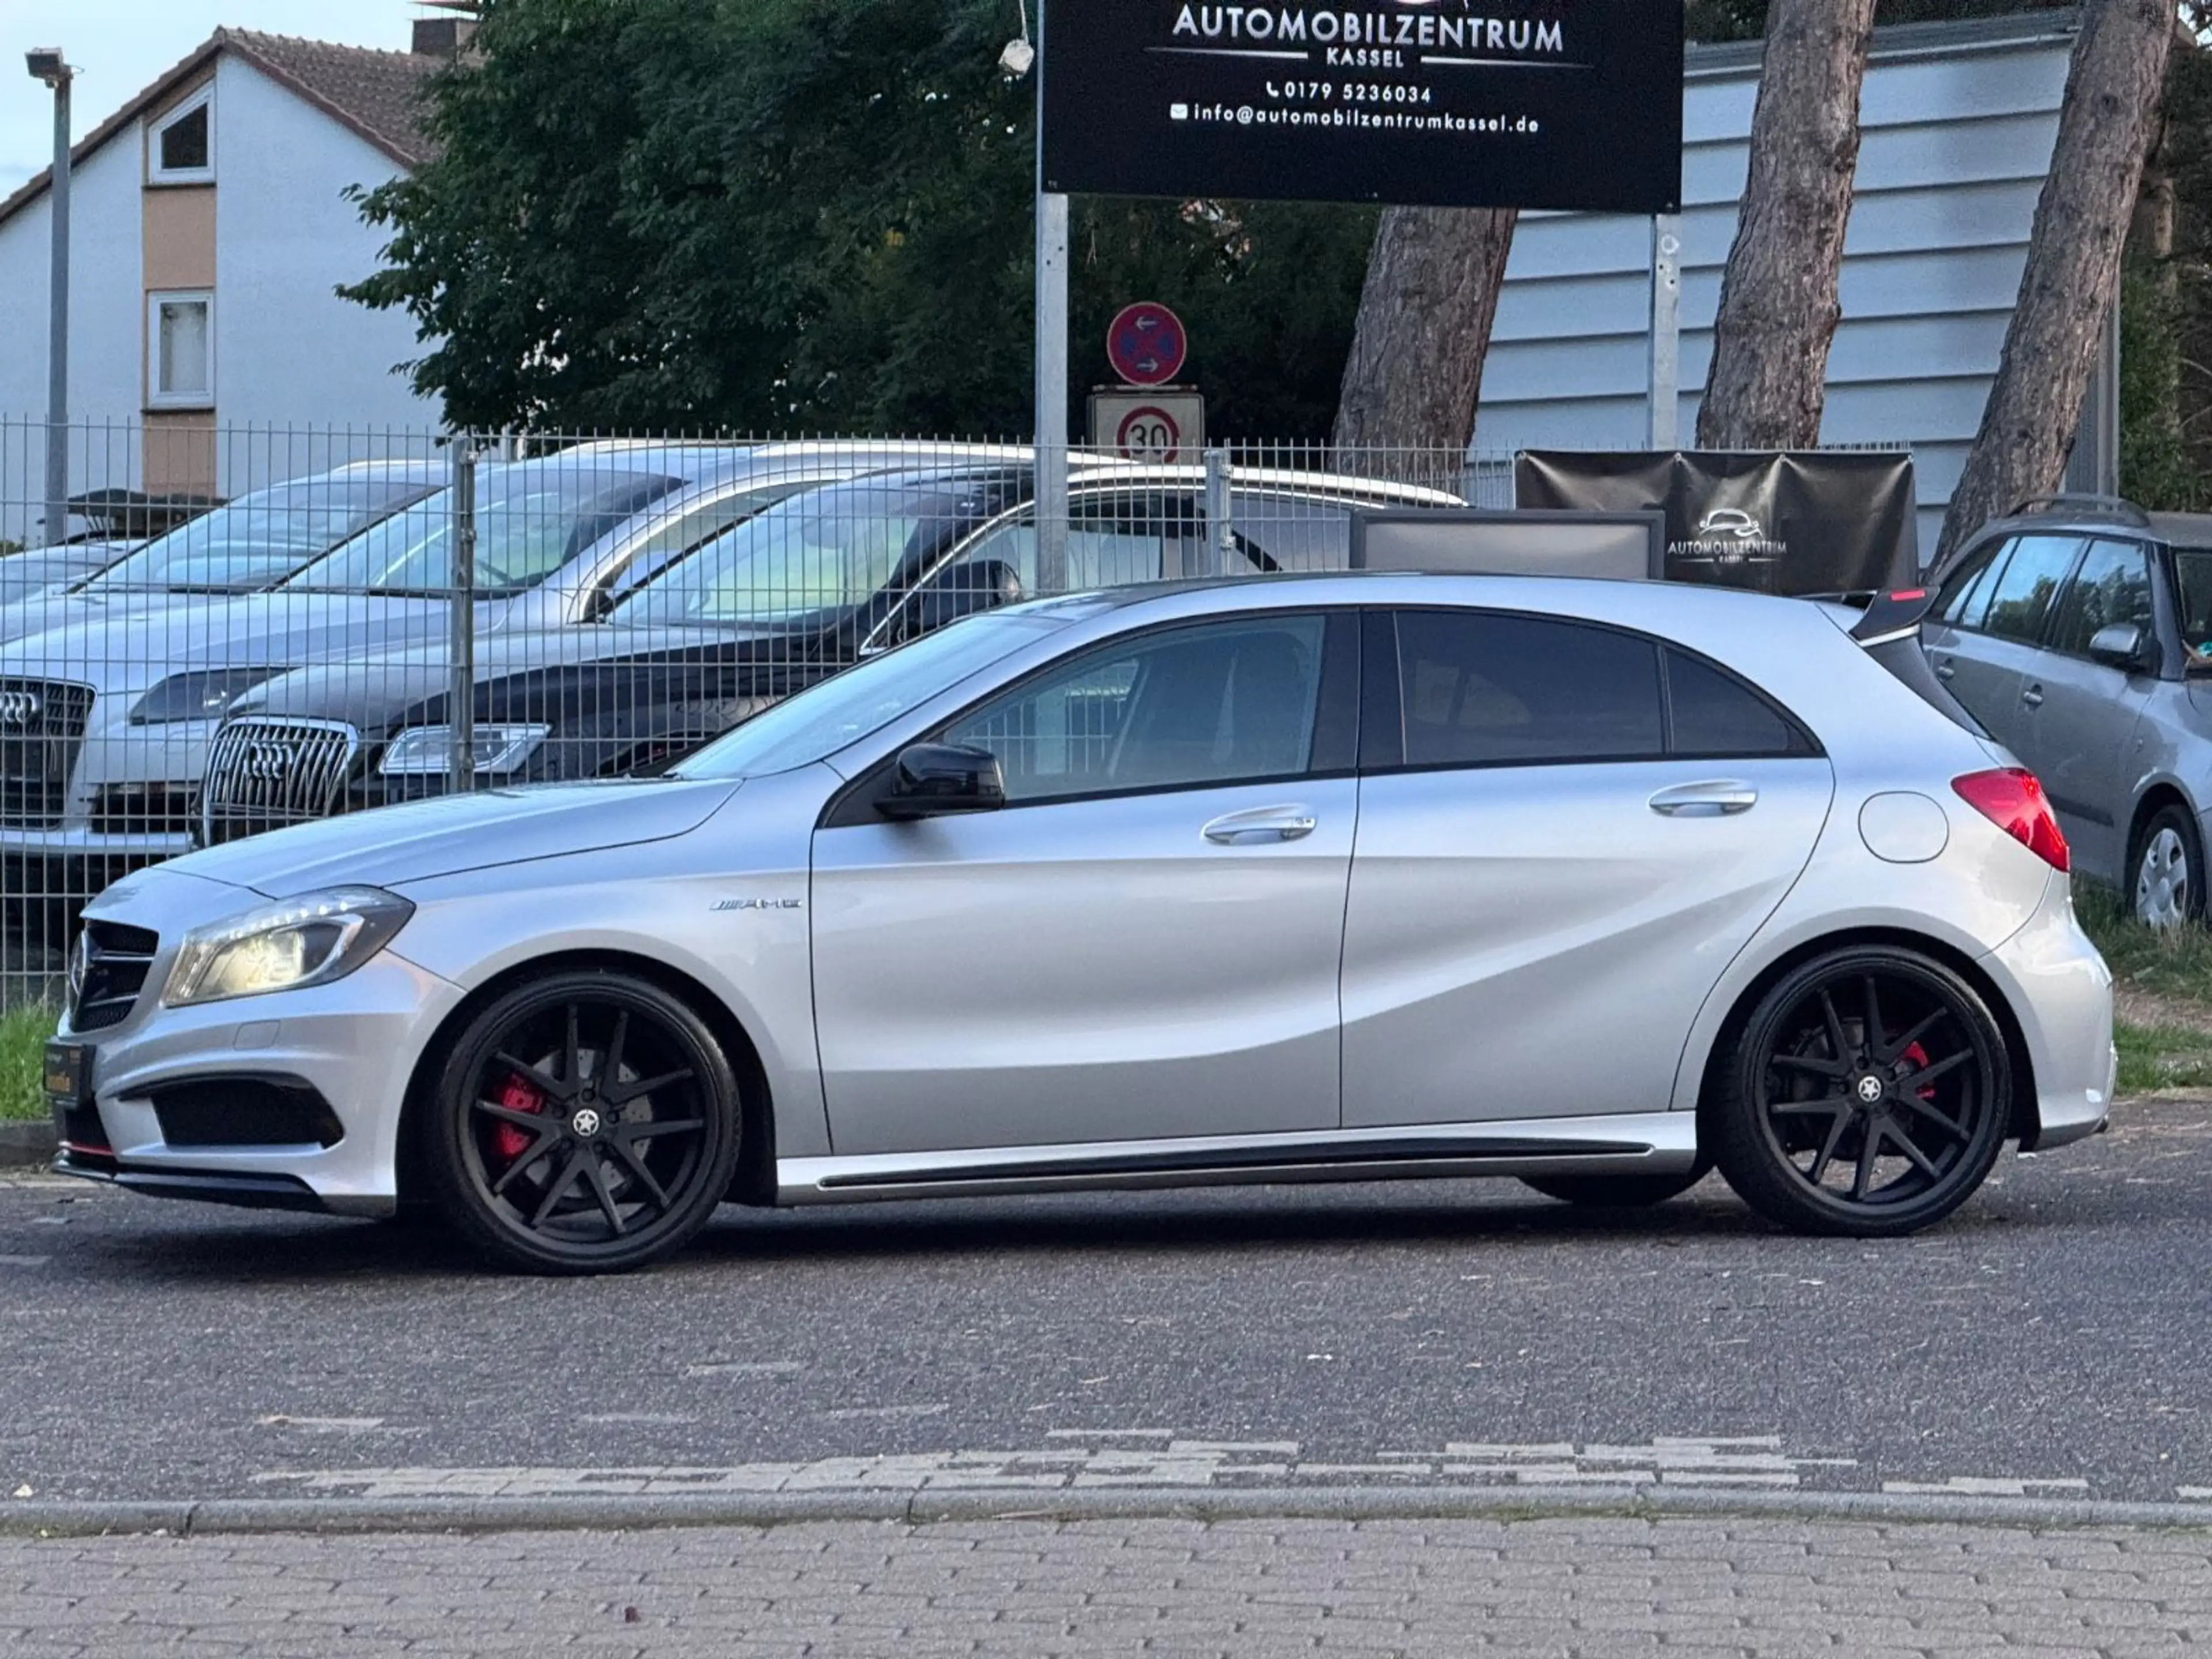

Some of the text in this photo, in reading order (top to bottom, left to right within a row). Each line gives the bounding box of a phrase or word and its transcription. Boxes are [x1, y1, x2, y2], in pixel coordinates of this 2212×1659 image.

[1172, 3, 1563, 52] AUTOMOBILZENTRUM
[1327, 46, 1404, 68] KASSEL
[1285, 81, 1431, 103] 0179 5236034
[1194, 103, 1539, 132] info@automobilzentrumkassel.de
[1130, 424, 1167, 454] 30
